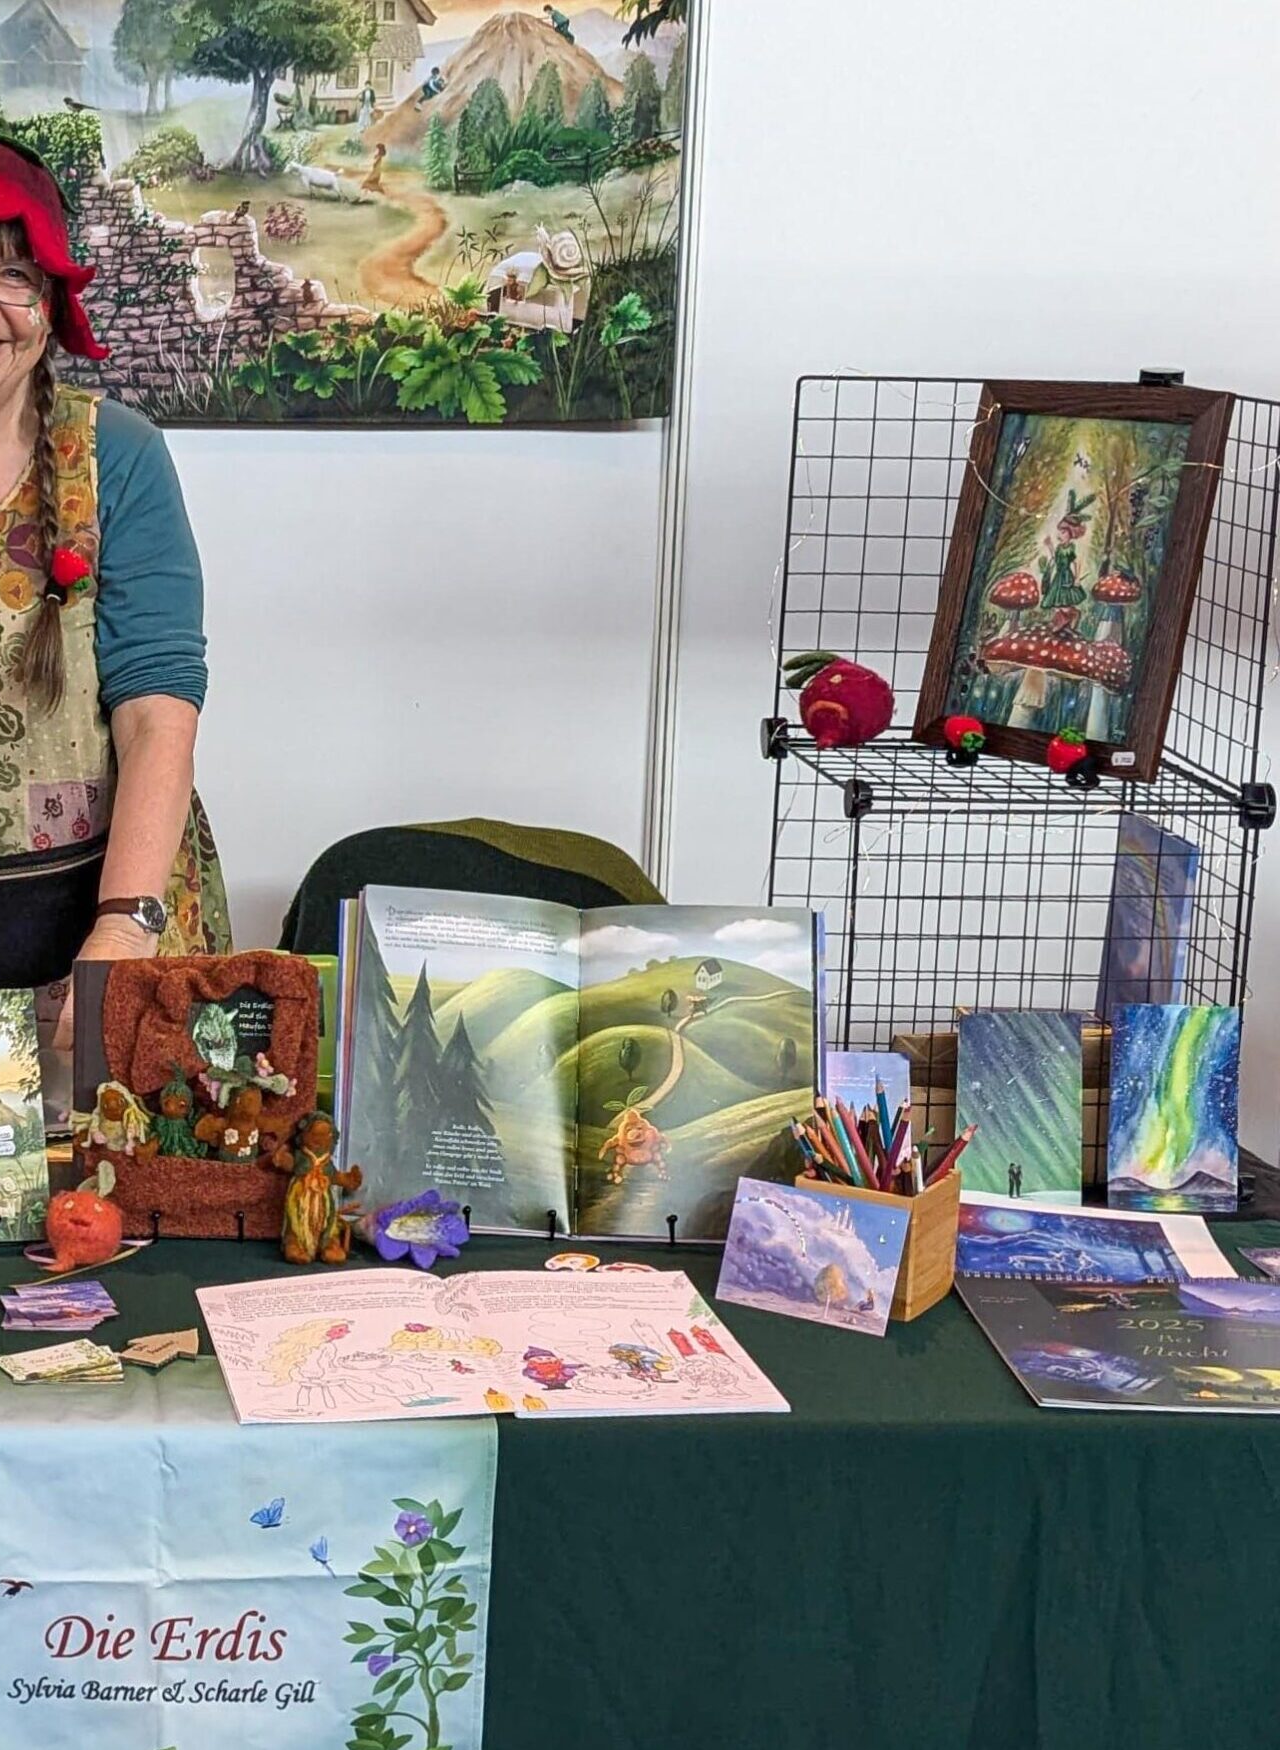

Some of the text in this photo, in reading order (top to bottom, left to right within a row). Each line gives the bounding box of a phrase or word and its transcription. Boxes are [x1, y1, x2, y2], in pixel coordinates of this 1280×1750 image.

[1116, 1318, 1205, 1332] 2025
[44, 1609, 288, 1662] Die Erdis
[7, 1675, 321, 1710] Sylvia Barner & Scharle Gill
